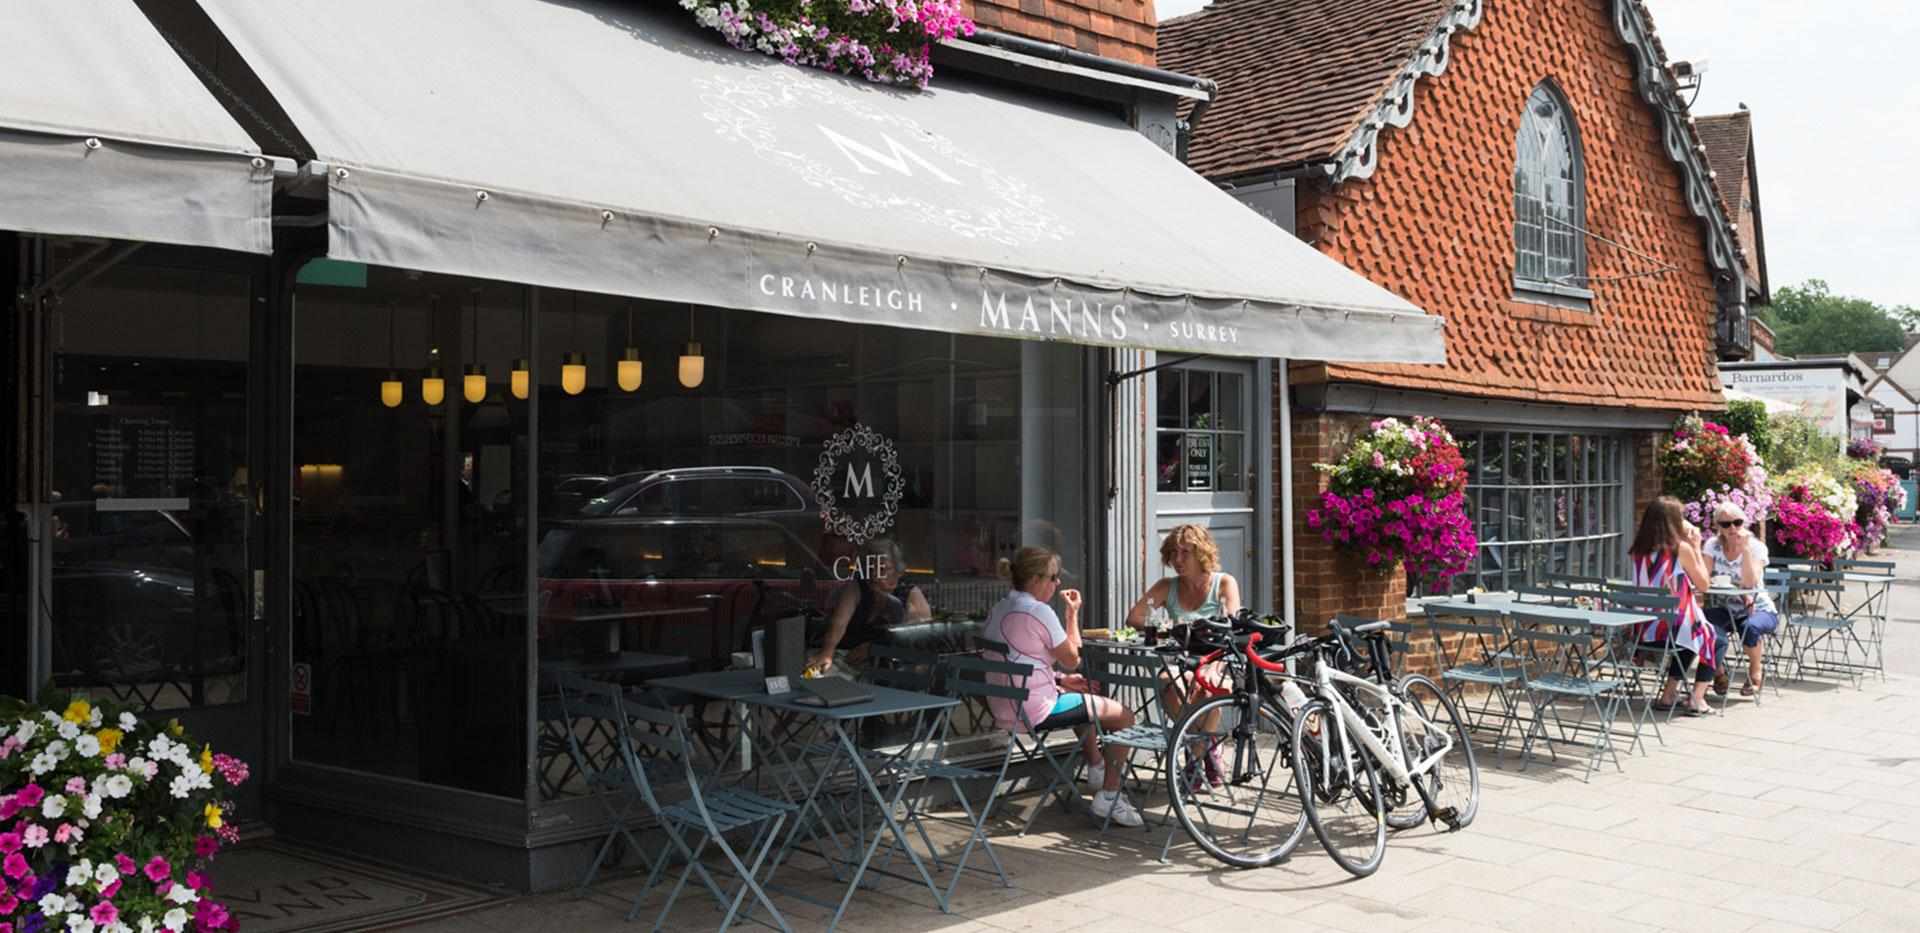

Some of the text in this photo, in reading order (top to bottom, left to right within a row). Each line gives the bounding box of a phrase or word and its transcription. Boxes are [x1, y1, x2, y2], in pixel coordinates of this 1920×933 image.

[816, 122, 960, 185] M
[759, 273, 1240, 345] CRANLEIGH MANNS SURREY
[843, 461, 875, 499] M
[832, 553, 888, 582] CAFE
